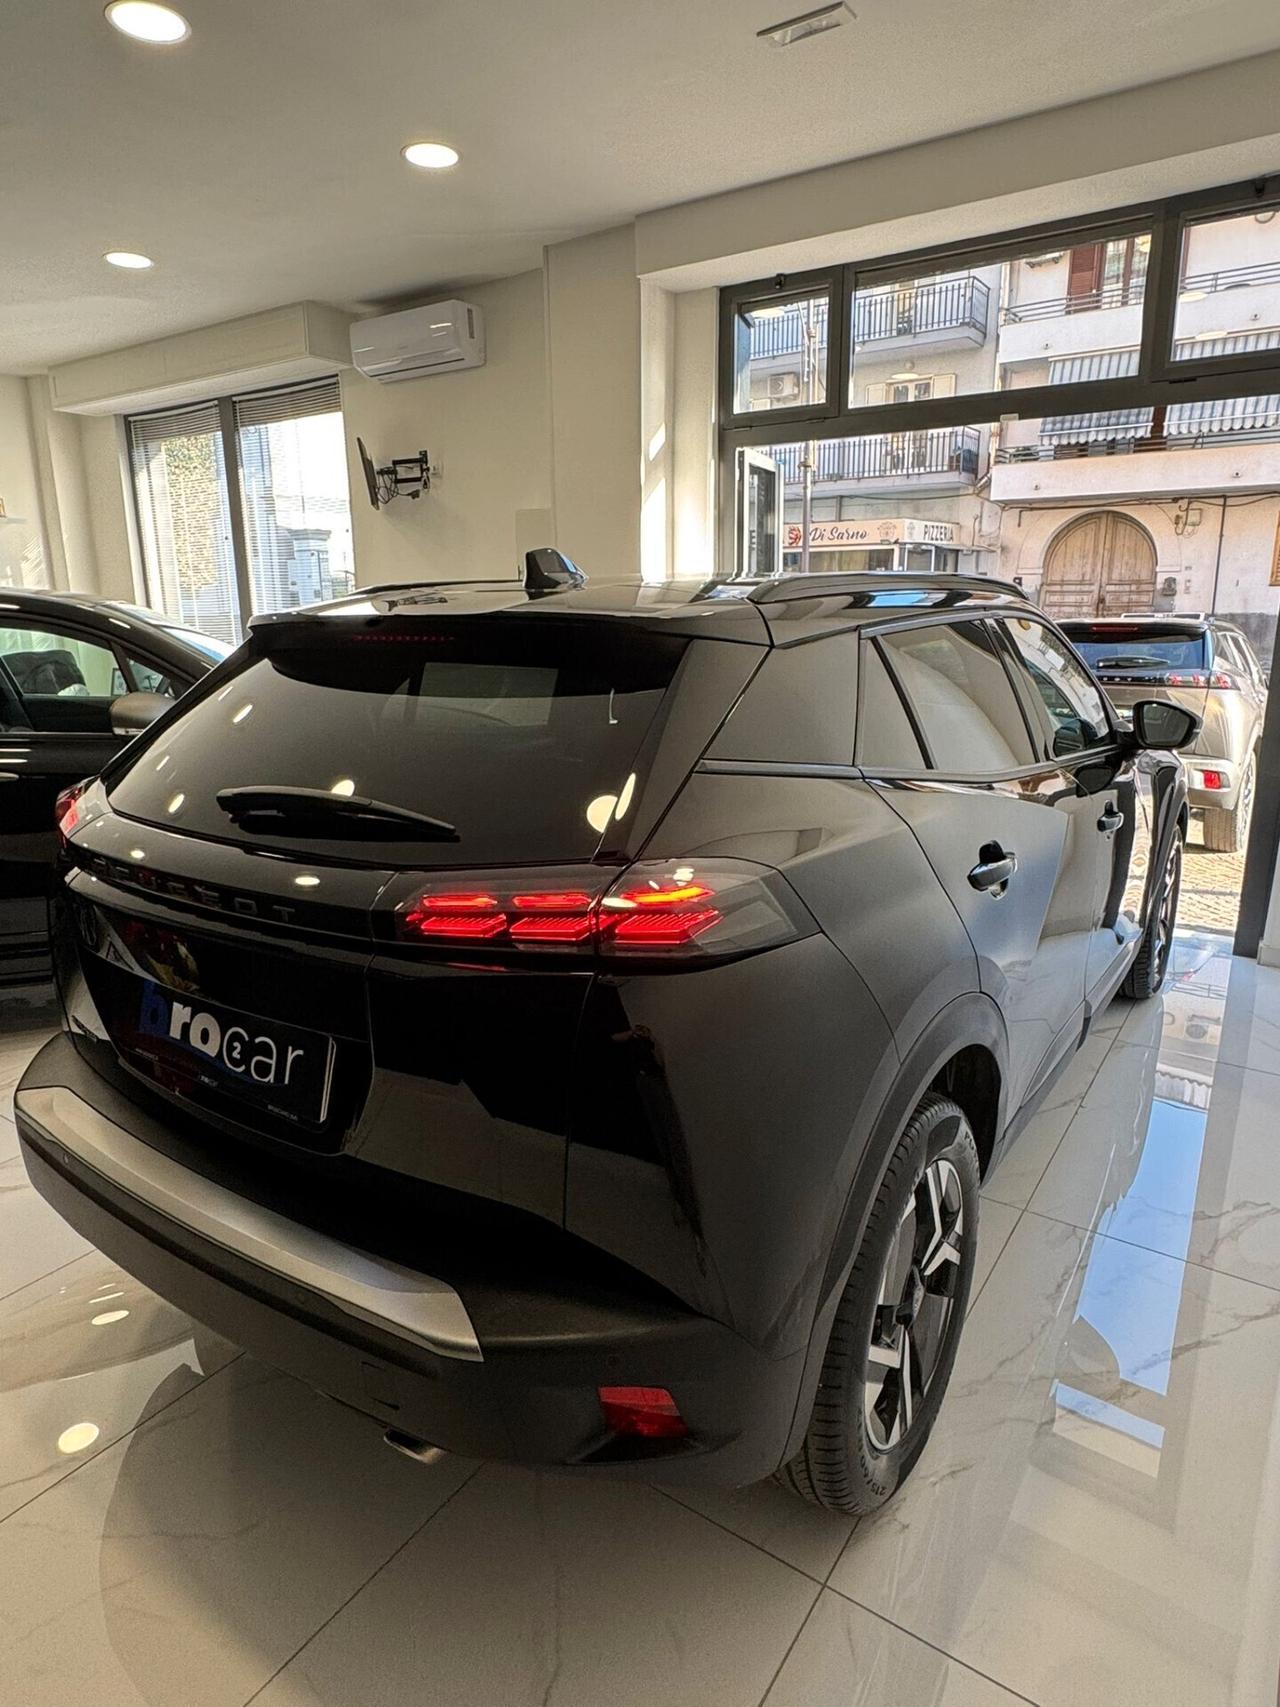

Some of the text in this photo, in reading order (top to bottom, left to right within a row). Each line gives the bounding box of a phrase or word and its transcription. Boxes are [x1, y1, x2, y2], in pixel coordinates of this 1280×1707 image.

[809, 526, 868, 543] Di Sarno
[923, 524, 953, 543] PIZZERIA
